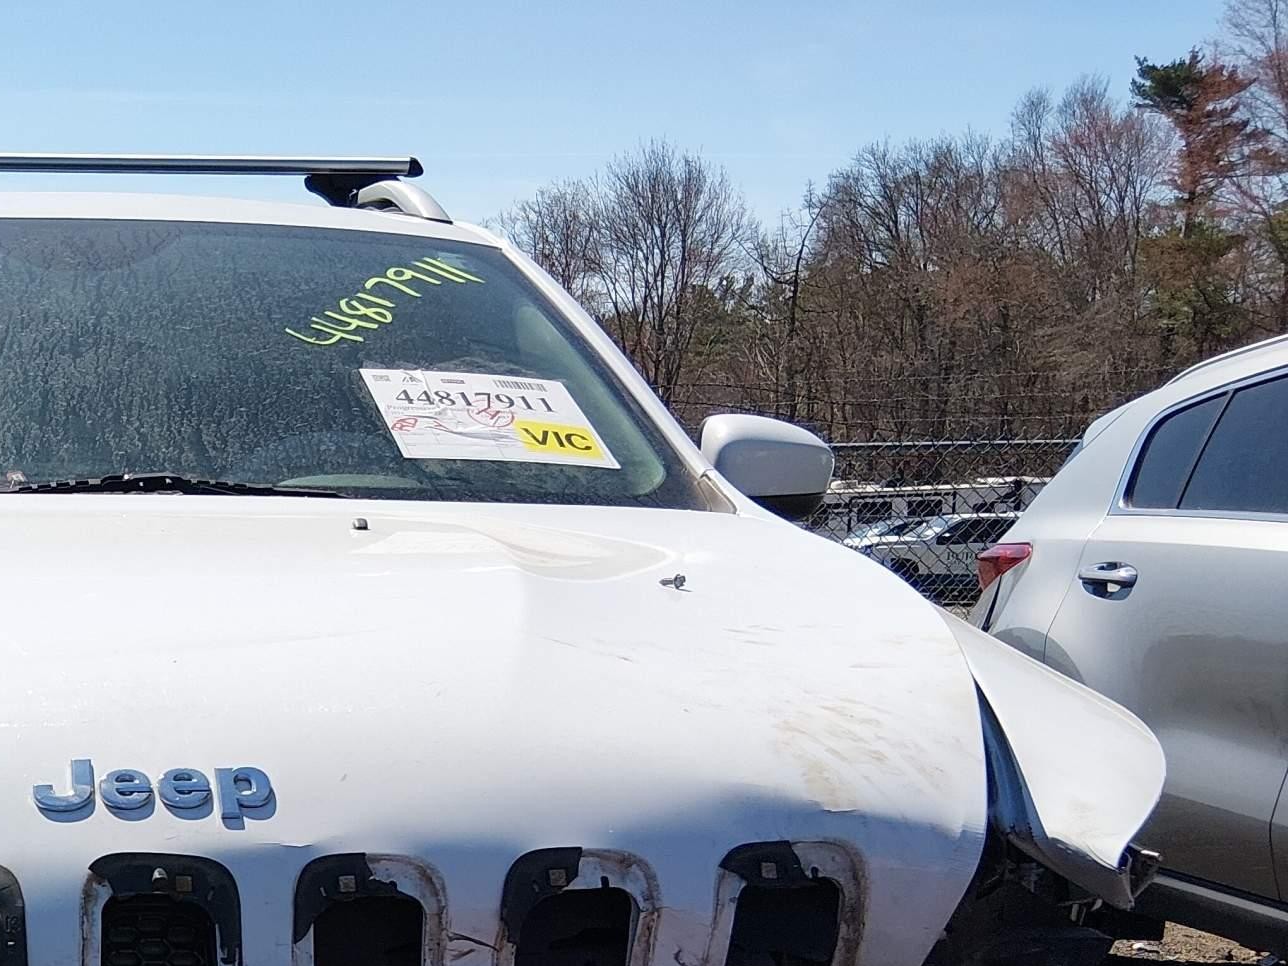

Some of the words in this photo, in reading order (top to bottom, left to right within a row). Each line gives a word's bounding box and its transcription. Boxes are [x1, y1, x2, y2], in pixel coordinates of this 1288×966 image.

[285, 256, 486, 345] 44817911
[396, 388, 557, 413] 44817911
[522, 426, 593, 451] VIC
[32, 758, 273, 825] Jeep
